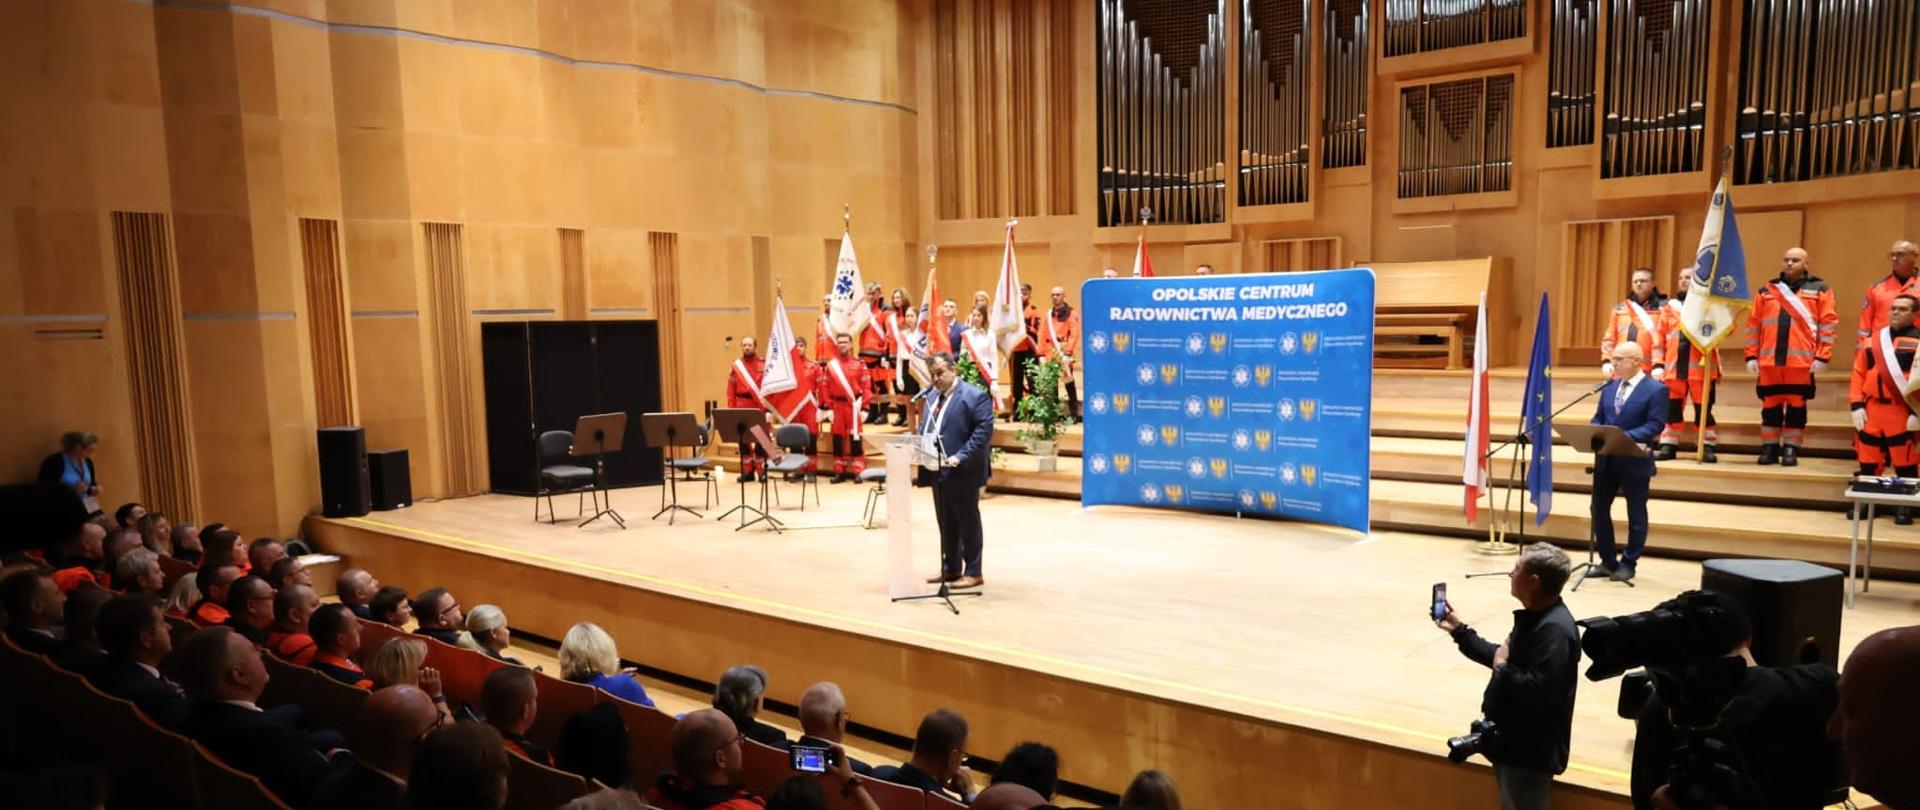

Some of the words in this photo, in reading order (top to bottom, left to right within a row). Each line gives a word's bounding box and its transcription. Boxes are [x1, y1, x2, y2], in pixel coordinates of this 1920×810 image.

[1152, 287, 1235, 301] OPOLSKIE
[1239, 283, 1314, 300] CENTRUM
[1110, 307, 1238, 321] RATOWNICTWA
[1242, 302, 1348, 321] MEDYCZNEGO
